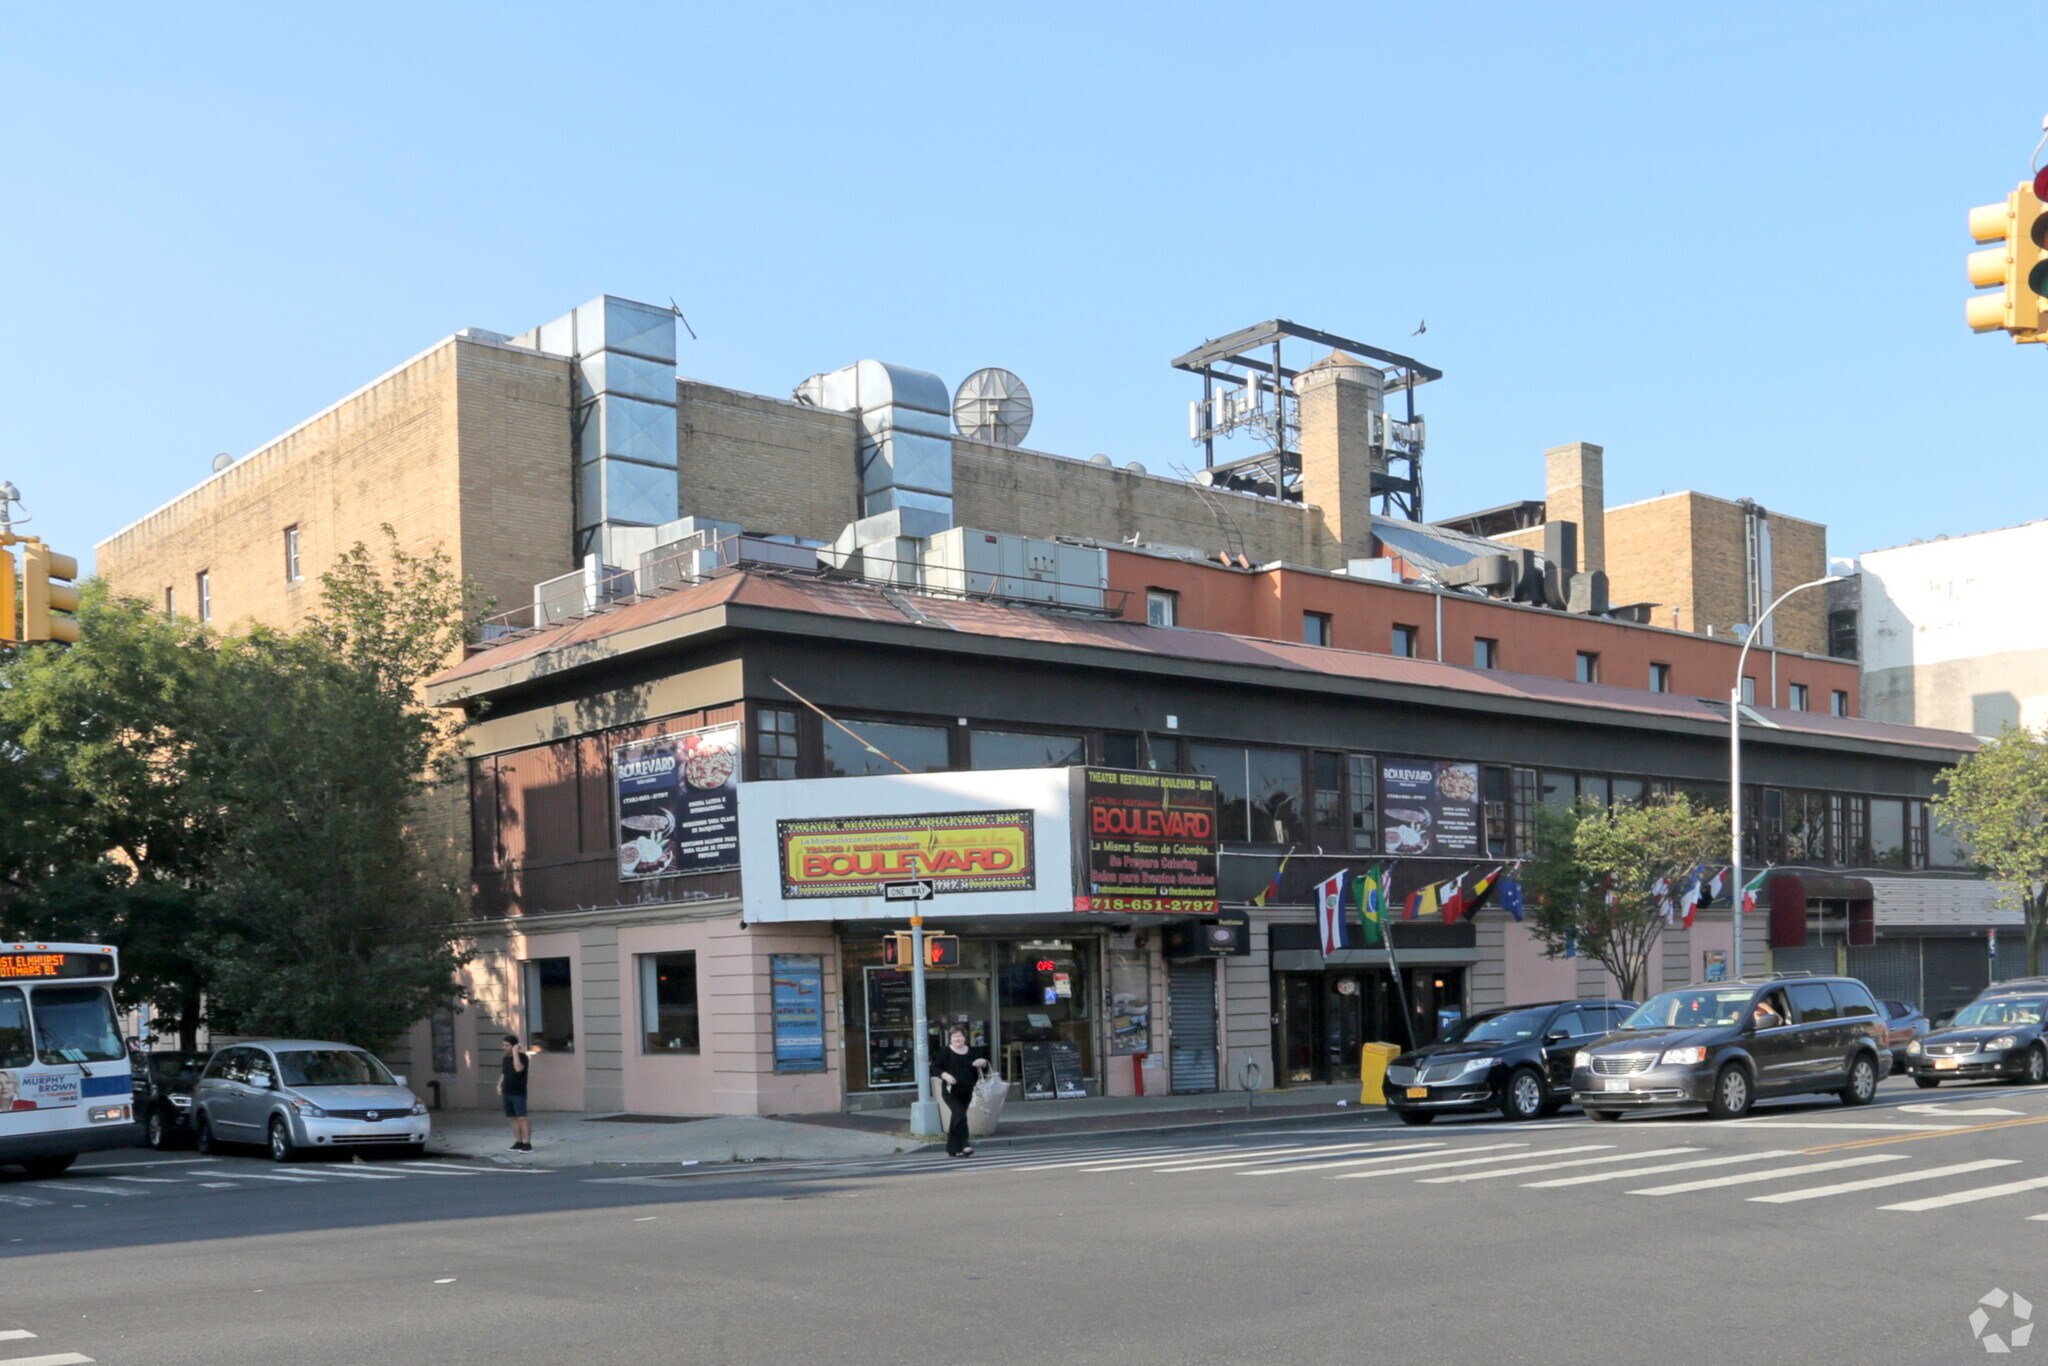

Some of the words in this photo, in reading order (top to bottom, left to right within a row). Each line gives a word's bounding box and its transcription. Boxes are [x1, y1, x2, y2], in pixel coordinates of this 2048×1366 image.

[618, 757, 674, 778] BOULEVARD
[1088, 771, 1118, 784] THEATER
[1120, 774, 1160, 787] RESTAURANT
[1160, 777, 1196, 789] BOULEVARD
[1200, 780, 1213, 791] BAR
[1383, 768, 1432, 781] BOULEVARD
[788, 823, 837, 831] THEATER
[843, 820, 915, 829] RESTAURANT
[919, 816, 987, 826] BOULEVARD
[1092, 806, 1211, 838] BOULEVARD
[1091, 840, 1101, 851] La
[1103, 841, 1131, 853] Misma
[1133, 842, 1158, 853] Sazon
[1160, 843, 1171, 854] de
[803, 848, 1013, 876] BOULEVARD
[891, 887, 905, 896] ONE
[911, 886, 926, 895] WAY
[1092, 899, 1214, 911] 718-651-2797
[0, 957, 14, 967] ST
[16, 955, 64, 967] ELMHURST
[0, 966, 42, 977] DITMARS
[22, 1076, 65, 1086] MURPHY
[38, 1083, 77, 1093] BROWN
